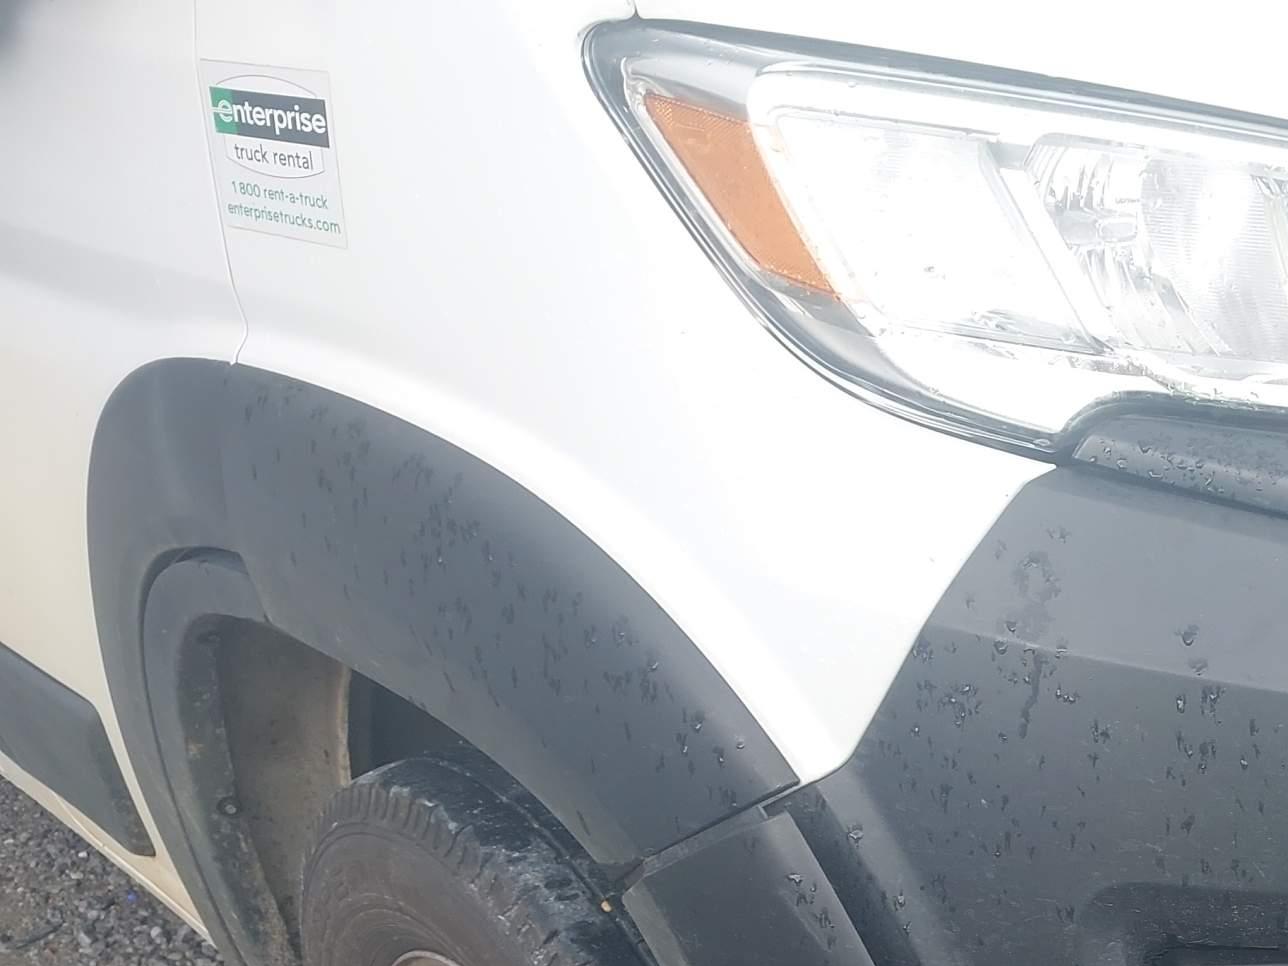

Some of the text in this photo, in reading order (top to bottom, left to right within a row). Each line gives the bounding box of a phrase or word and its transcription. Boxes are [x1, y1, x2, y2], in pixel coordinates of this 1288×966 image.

[213, 99, 327, 135] enterprise
[234, 144, 314, 170] truck rental
[263, 187, 329, 209] rent-a-truck
[227, 202, 341, 234] enterprisetrucks.com
